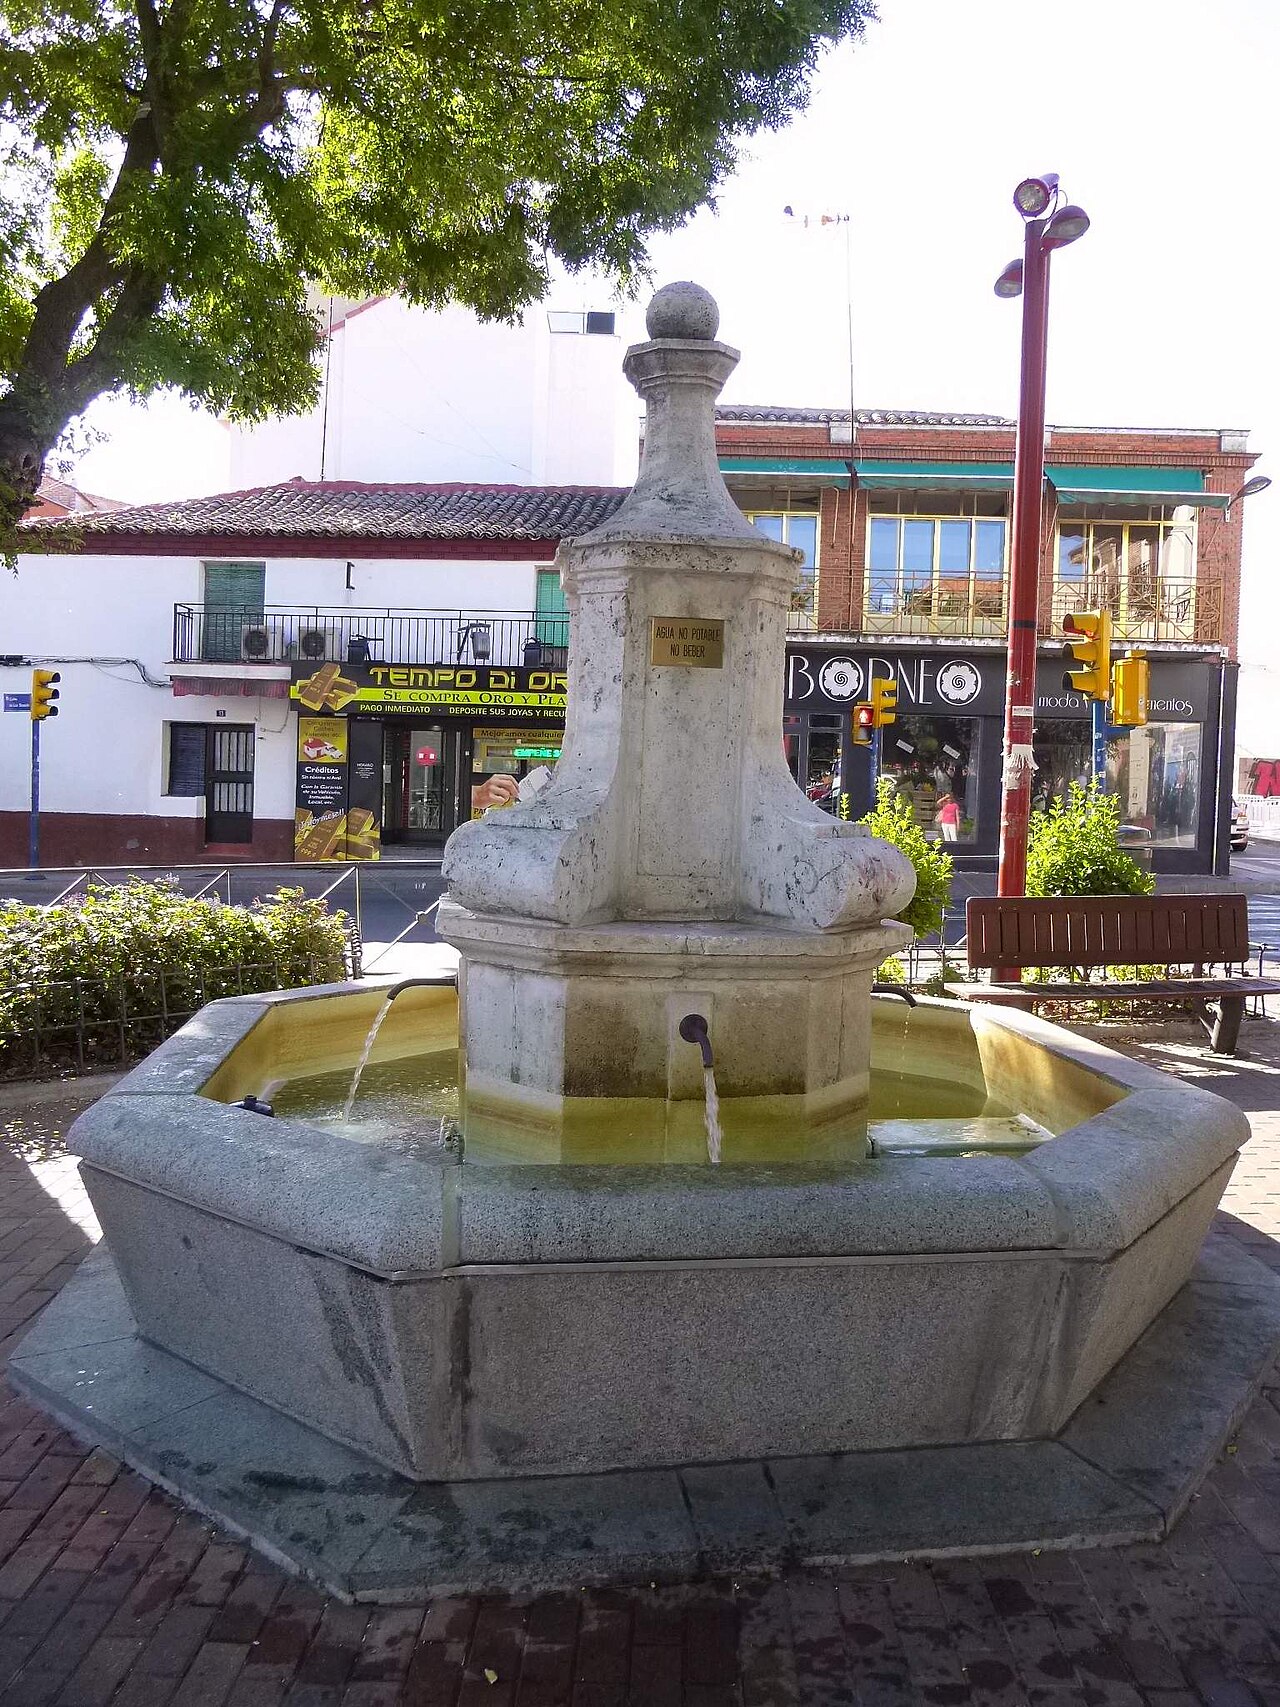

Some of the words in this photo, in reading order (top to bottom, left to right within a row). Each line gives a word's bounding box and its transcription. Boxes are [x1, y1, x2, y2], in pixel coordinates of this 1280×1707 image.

[655, 626, 675, 640] AGUA
[678, 627, 688, 640] NO
[691, 628, 721, 642] POTABLE
[670, 643, 680, 657] NO
[683, 644, 705, 658] BEBER
[369, 667, 477, 688] TEMPO
[360, 704, 383, 712] PAGO
[385, 705, 431, 713] INMEDIATO
[449, 706, 488, 715] DEPOSITE
[489, 707, 506, 716] SUS
[508, 708, 534, 717] JOYAS
[535, 709, 542, 717] Y
[1038, 693, 1080, 708] moda
[1146, 697, 1194, 717] mentos
[481, 729, 527, 739] Mejoramos
[304, 766, 339, 774] Créditos
